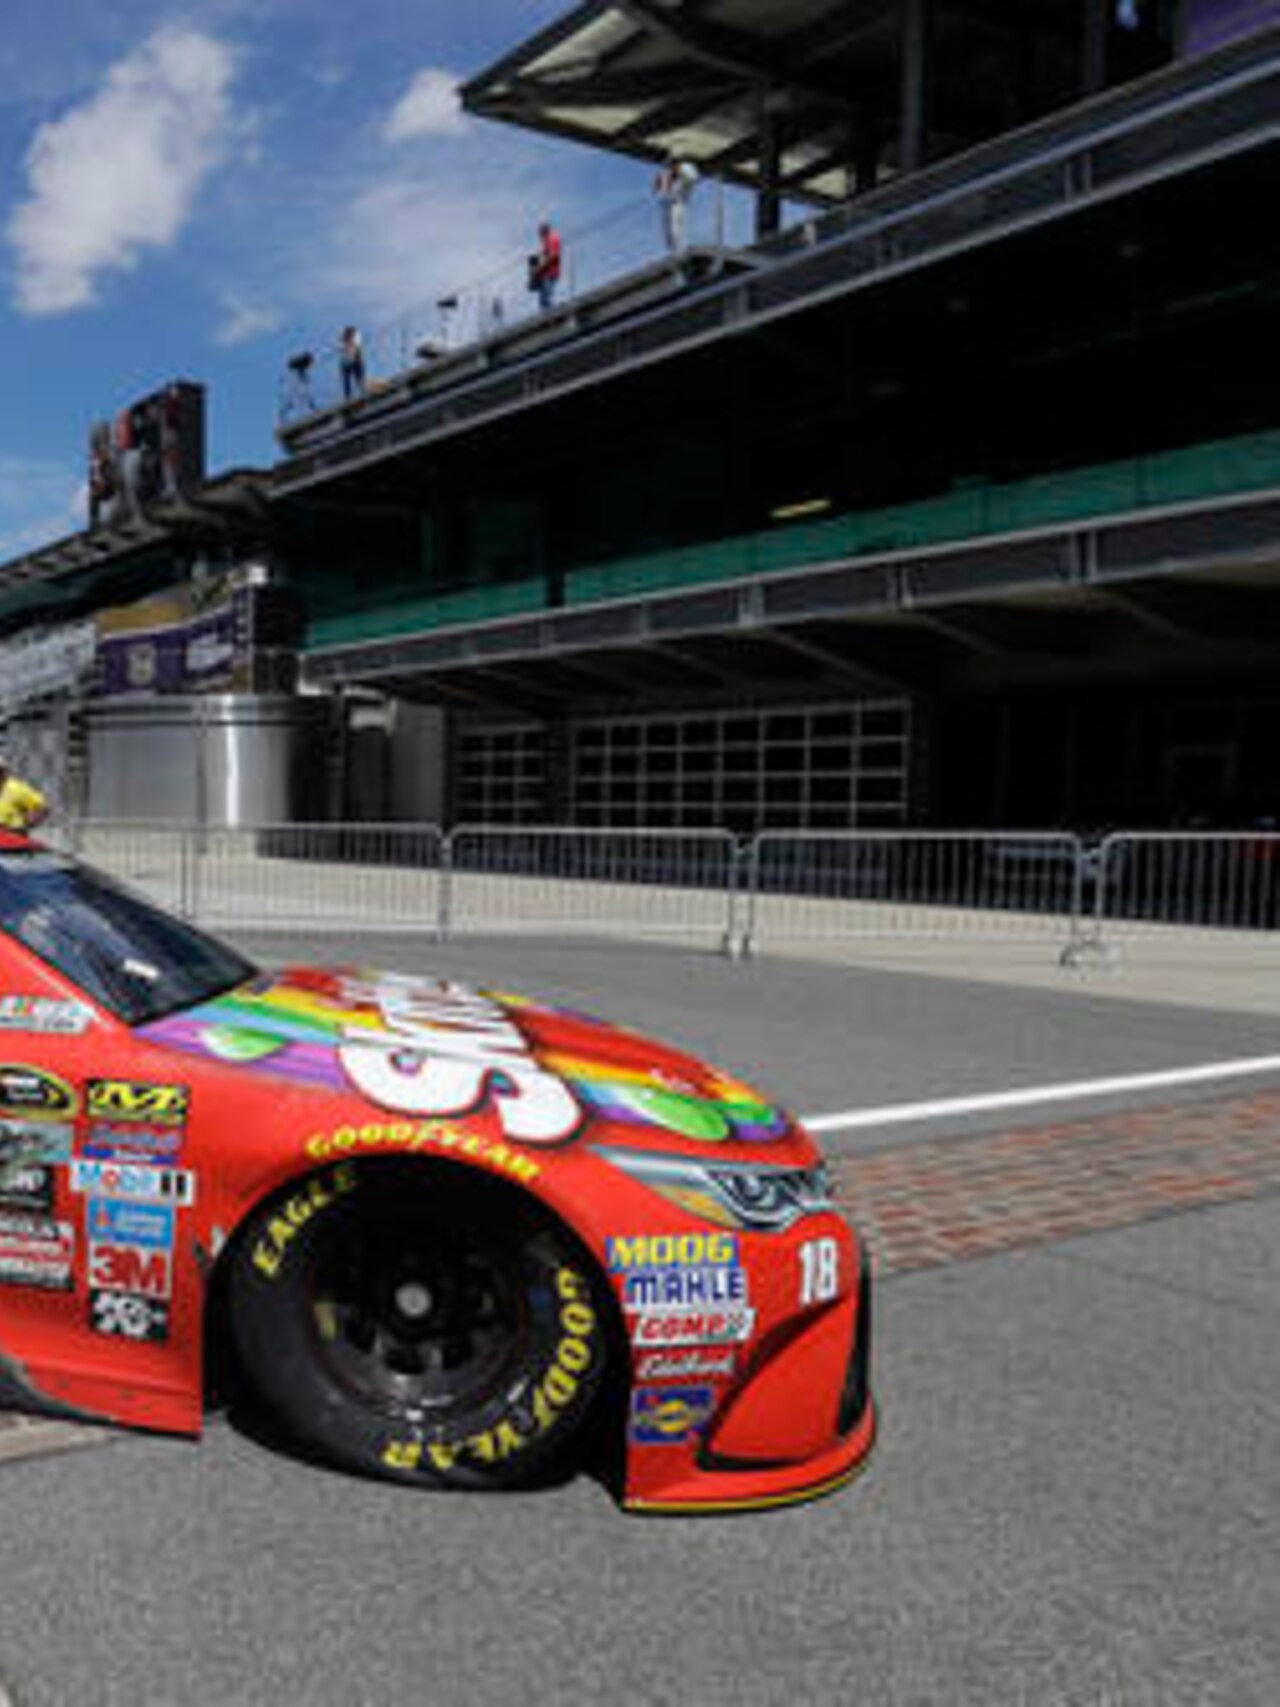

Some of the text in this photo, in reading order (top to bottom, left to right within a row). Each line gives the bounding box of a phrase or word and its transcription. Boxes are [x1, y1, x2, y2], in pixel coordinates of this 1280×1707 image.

[305, 1121, 541, 1182] GOODYEAR
[252, 1166, 357, 1277] EAGLE
[607, 1233, 733, 1268] MOOG
[94, 1246, 167, 1294] 3M
[628, 1270, 745, 1304] MAHLE
[800, 1237, 838, 1304] 18
[382, 1269, 596, 1468] GOODYEAR
